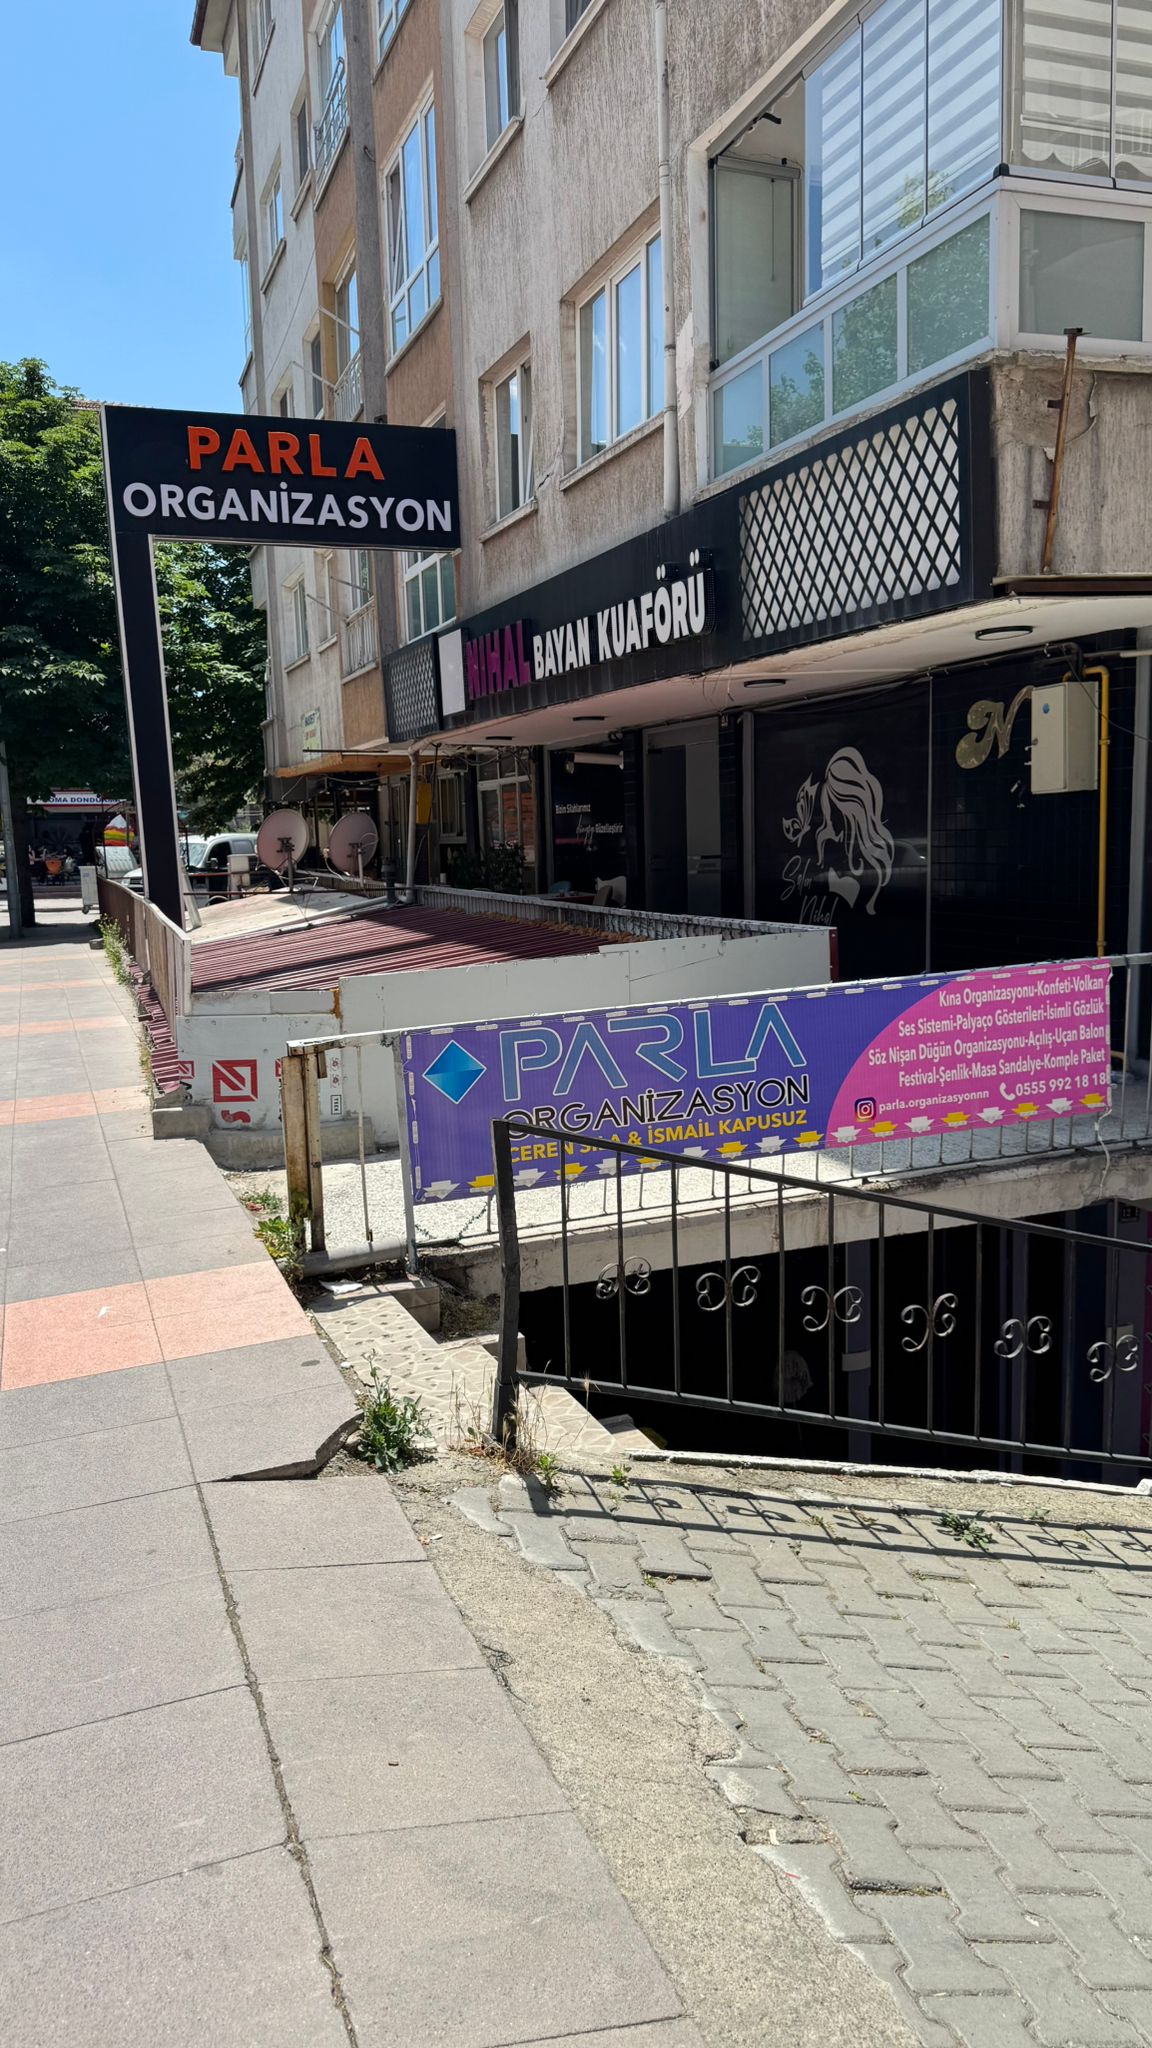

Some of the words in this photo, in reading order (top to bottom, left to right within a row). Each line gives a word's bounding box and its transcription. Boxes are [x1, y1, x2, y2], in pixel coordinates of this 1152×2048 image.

[187, 426, 385, 481] PARLA
[123, 481, 452, 532] ORGANİZASYON
[533, 617, 591, 680] BAYAN
[597, 548, 706, 662] KUAFÖRÜ
[939, 990, 961, 1008] Kına
[963, 974, 1104, 1008] Organizasyonu-Konfeti-Volkan
[898, 1020, 916, 1037] Ses
[917, 1013, 993, 1036] Sistemi-Palyaço
[1073, 997, 1105, 1017] Gözlük
[500, 1002, 808, 1102] PARLA
[868, 1048, 887, 1066] Söz
[889, 1046, 917, 1067] Nişan
[919, 1041, 952, 1063] Düğün
[954, 1028, 1078, 1059] Organizasyonu-Açılış-Uçan
[1080, 1023, 1105, 1042] Balon
[898, 1062, 997, 1088] Festival-Şenlik-Masa
[999, 1050, 1079, 1076] Sandalye-Komple
[1081, 1046, 1105, 1065] Paket
[503, 1074, 810, 1141] ORGANİZASYON
[879, 1089, 990, 1114] parla.organizasyonnn
[1015, 1080, 1047, 1097] 0555
[1049, 1077, 1072, 1092] 992
[1074, 1075, 1089, 1089] 18
[1092, 1072, 1106, 1086] 18
[628, 1131, 643, 1146] &
[648, 1123, 714, 1145] İSMAİL
[719, 1110, 808, 1135] KAPUSUZ
